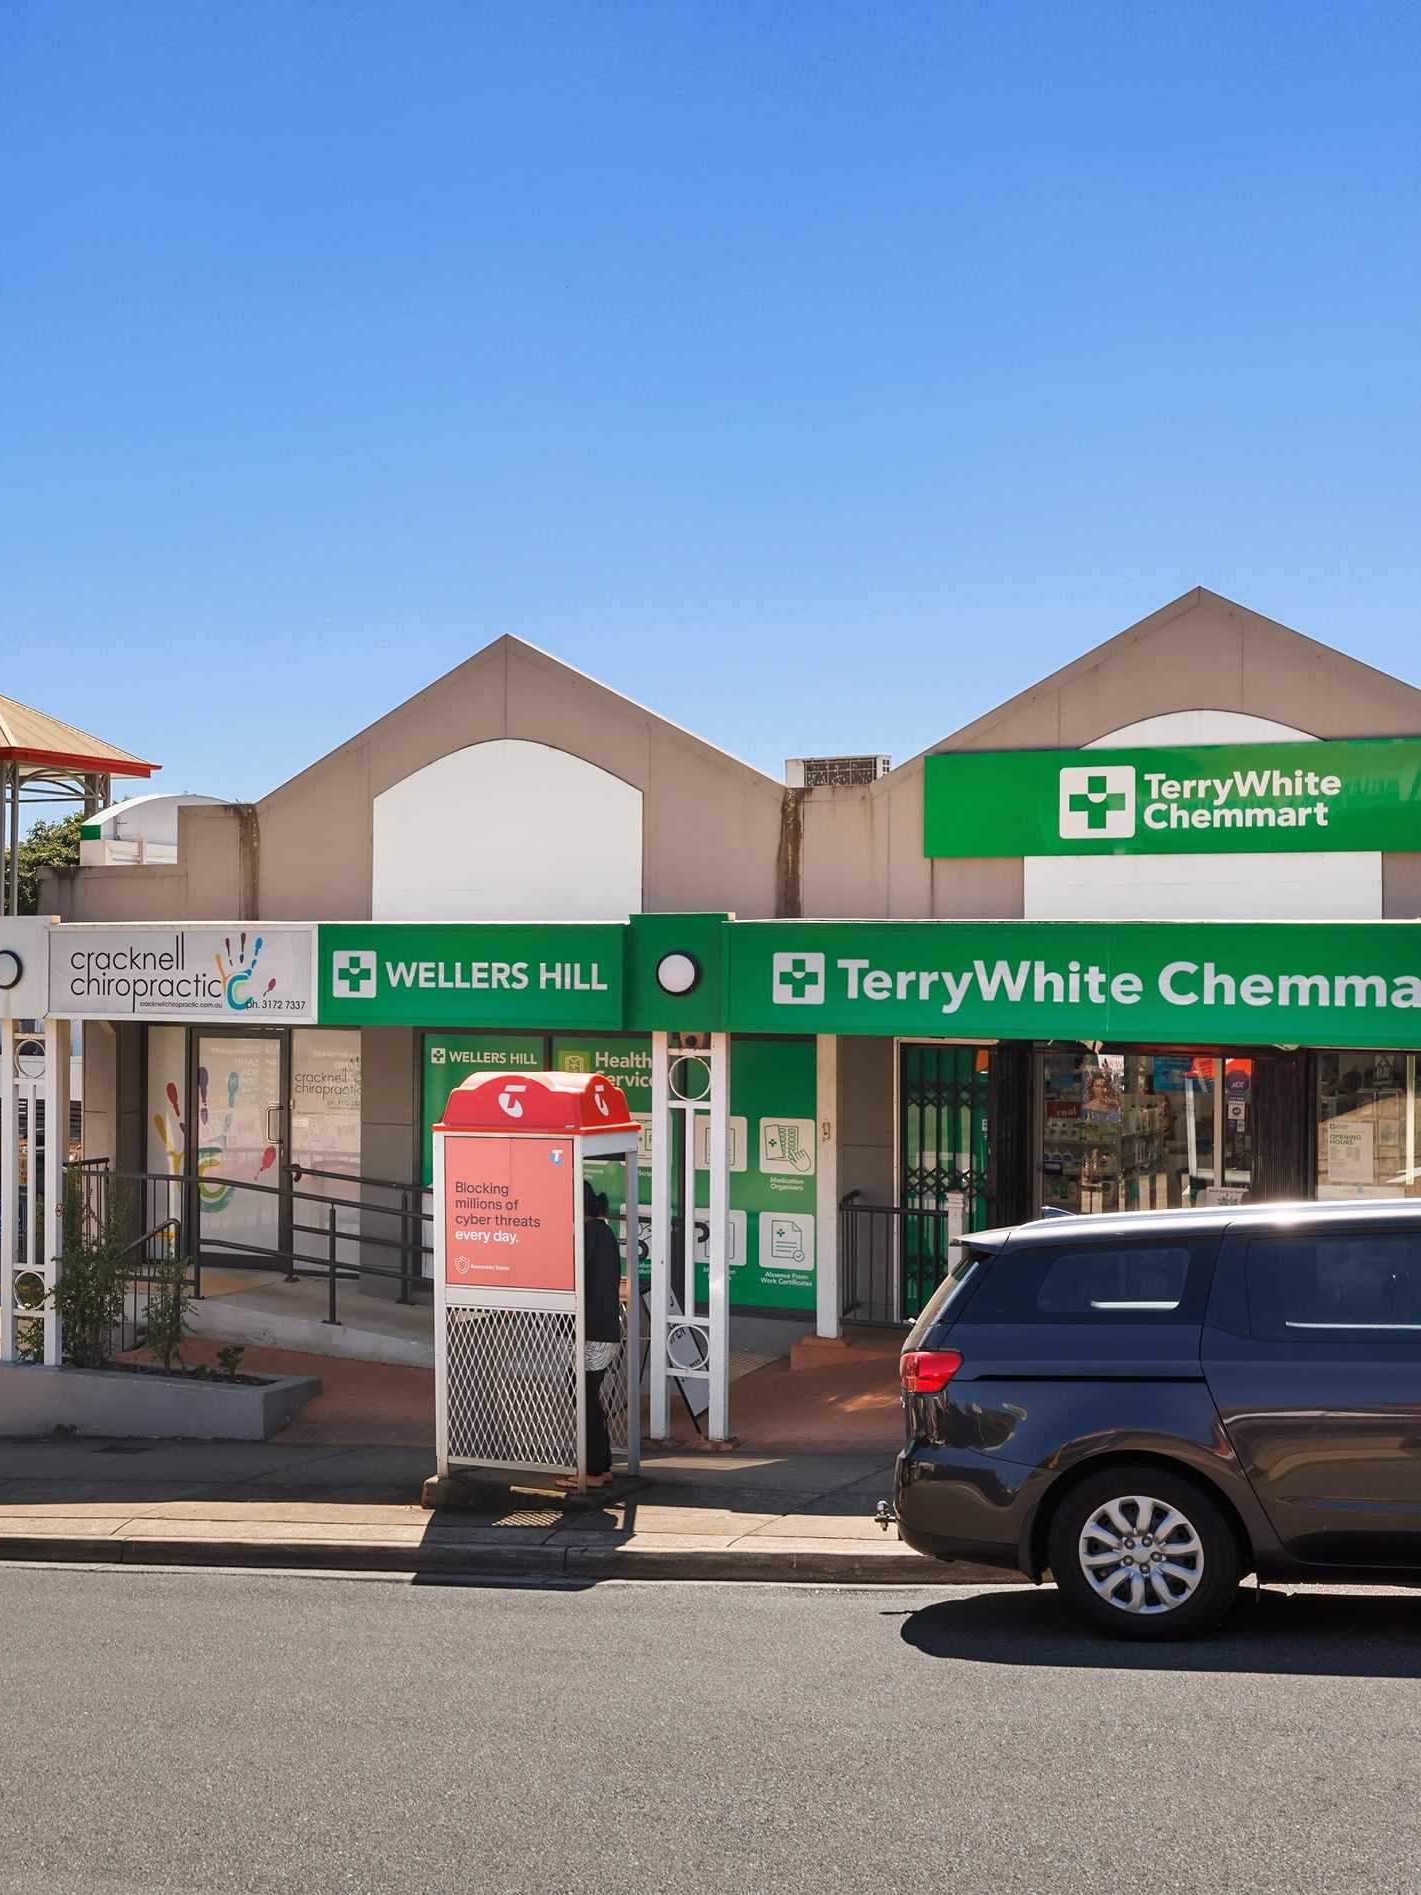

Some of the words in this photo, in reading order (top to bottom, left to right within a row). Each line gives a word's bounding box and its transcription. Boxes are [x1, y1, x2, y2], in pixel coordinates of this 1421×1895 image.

[1143, 769, 1342, 801] TerryWhite
[1143, 803, 1329, 830] Chemmart
[70, 931, 185, 970] cracknell
[385, 961, 529, 990] WELLERS
[539, 962, 608, 991] HILL
[70, 972, 222, 1013] chiropractic
[837, 958, 1144, 1014] TerryWhite
[1158, 961, 1421, 1009] Chemma
[139, 1000, 223, 1009] cracknellchiropractic.com.au
[246, 1000, 260, 1010] ph.
[262, 1000, 282, 1009] 3172
[285, 1000, 306, 1010] 7337
[450, 1051, 507, 1063] WELLERS
[510, 1053, 537, 1065] HILL
[595, 1051, 652, 1069] Health
[595, 1070, 652, 1088] ervic
[1056, 1107, 1077, 1116] real
[770, 1177, 805, 1185] Medication
[770, 1183, 804, 1191] Organisers
[455, 1181, 509, 1197] Blocking
[455, 1197, 503, 1210] millions
[505, 1199, 519, 1211] of
[455, 1213, 492, 1227] cyber
[494, 1215, 541, 1228] threats
[455, 1230, 491, 1244] every
[493, 1230, 519, 1245] day.
[765, 1271, 790, 1279] Absence
[778, 1278, 813, 1287] Certificates
